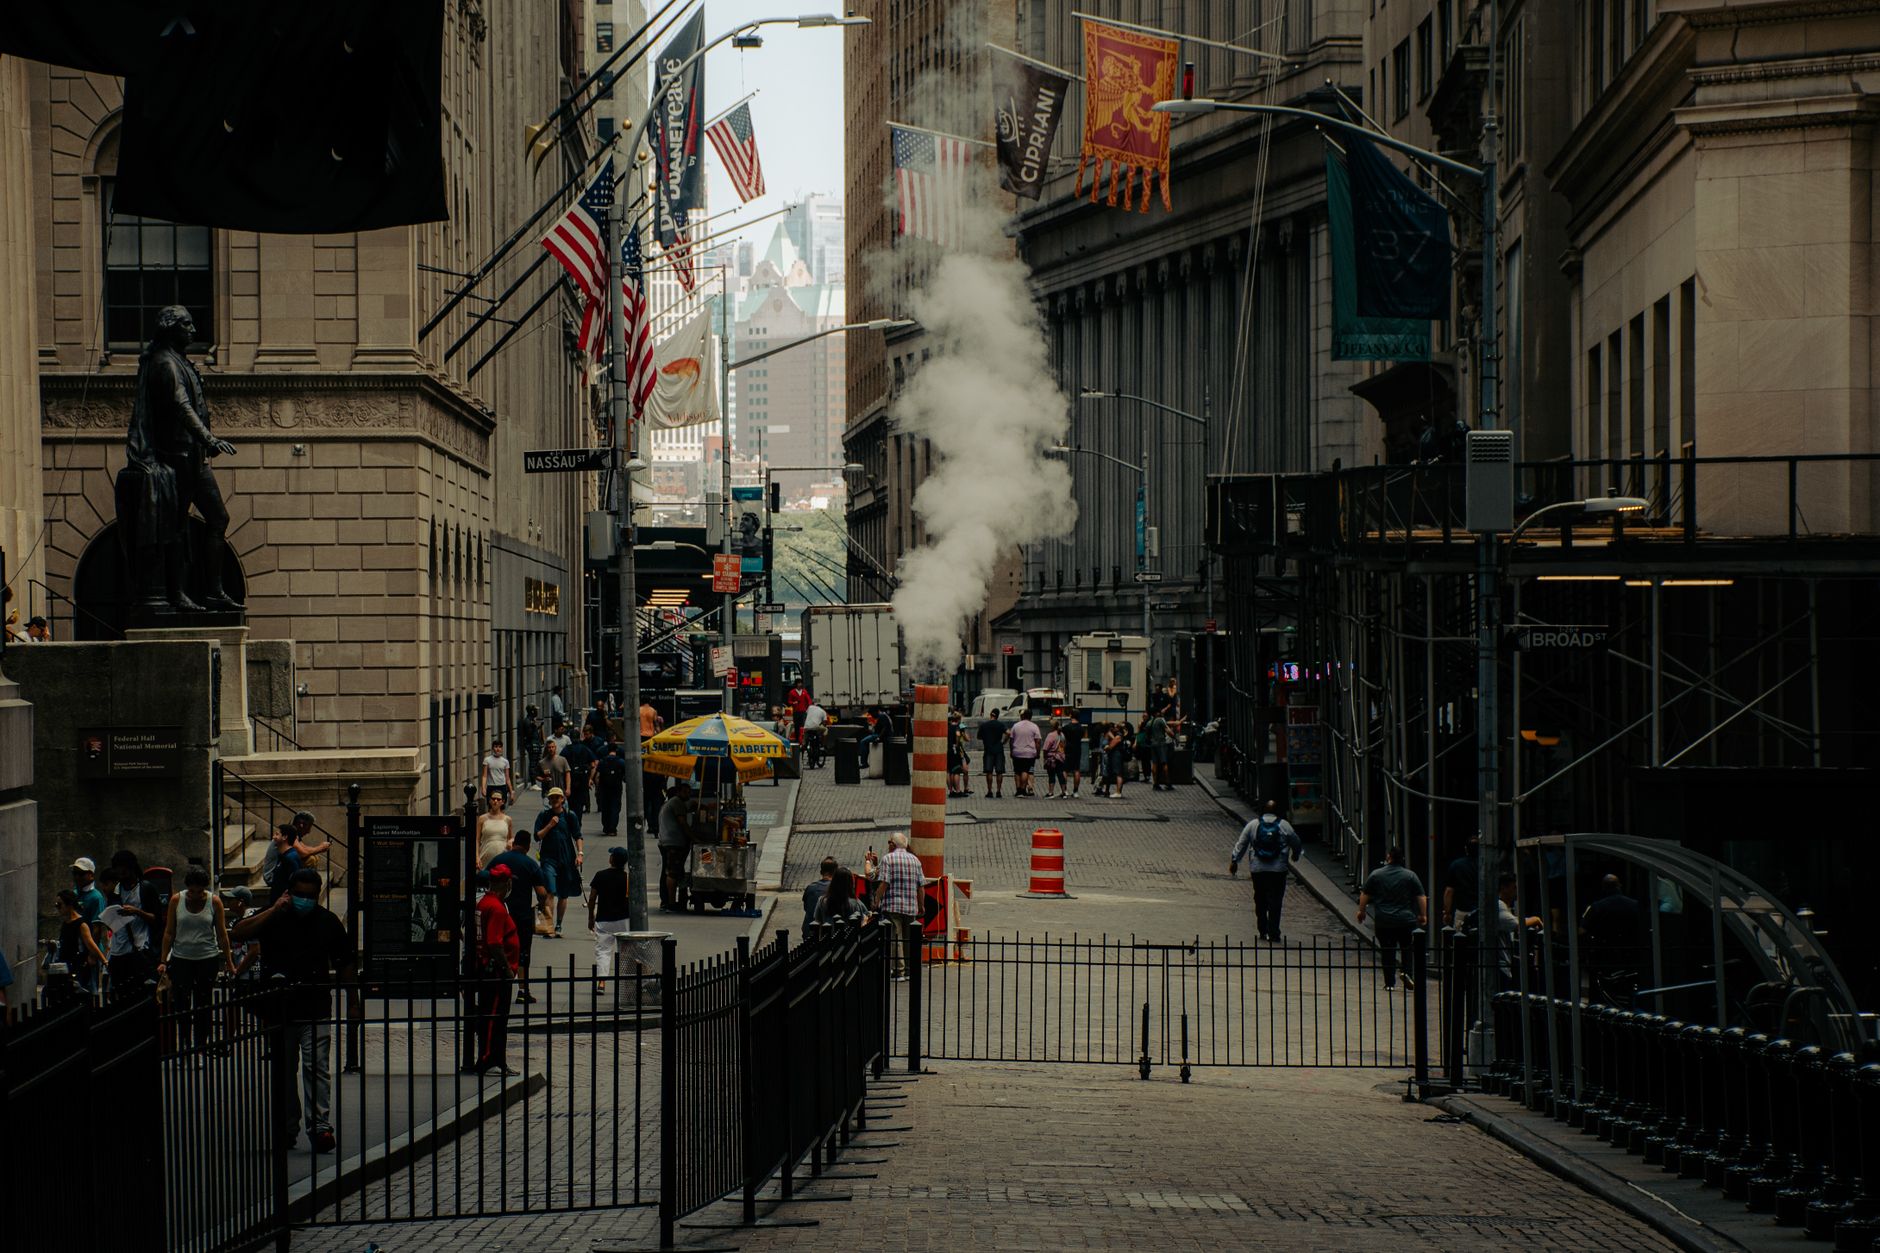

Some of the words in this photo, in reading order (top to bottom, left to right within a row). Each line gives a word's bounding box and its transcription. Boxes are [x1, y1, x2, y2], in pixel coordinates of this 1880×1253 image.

[1020, 86, 1056, 183] CIPRIANI
[526, 455, 577, 470] NASSAU
[576, 454, 586, 463] ST
[1532, 632, 1595, 647] BROAD
[1594, 632, 1608, 640] ST
[733, 743, 778, 754] SABRETT
